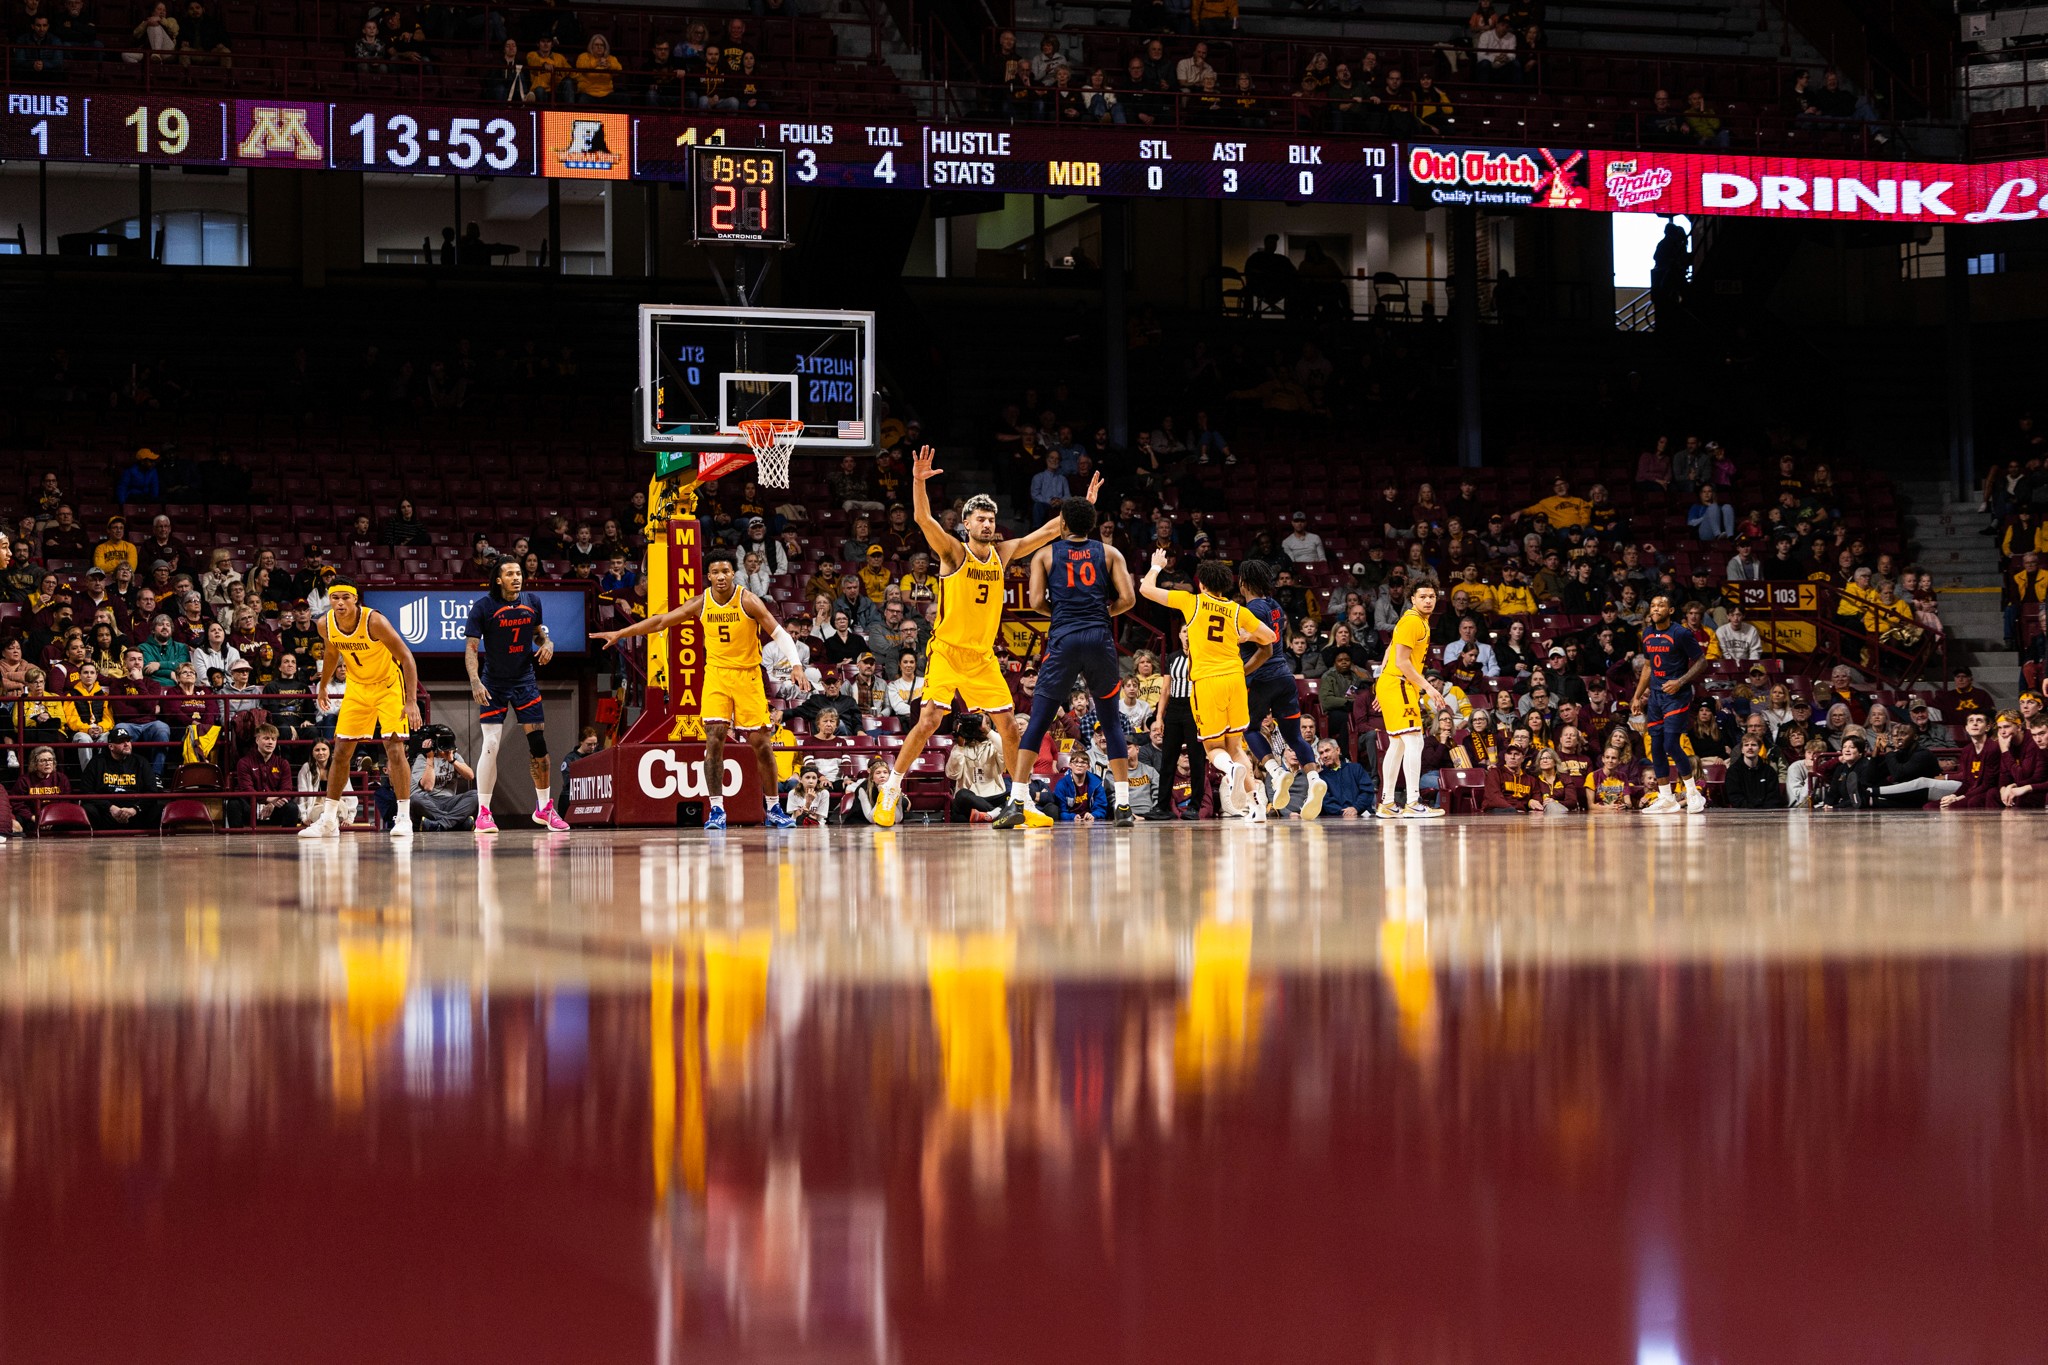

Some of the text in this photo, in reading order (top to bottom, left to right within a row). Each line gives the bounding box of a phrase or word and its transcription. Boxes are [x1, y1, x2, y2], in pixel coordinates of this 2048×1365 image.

[9, 94, 68, 116] FOULS
[30, 119, 48, 155] 1
[125, 106, 190, 154] 19
[779, 123, 834, 145] FOULS
[350, 113, 519, 171] 13:53
[931, 130, 1011, 156] HUSTLE
[1139, 139, 1173, 160] STL
[1212, 142, 1247, 162] AST
[796, 148, 818, 183] 3
[1288, 144, 1322, 165] BLK
[1362, 147, 1386, 167] TO
[873, 150, 897, 184] 4
[933, 160, 995, 185] STATS
[1049, 160, 1100, 187] MOR
[1147, 165, 1163, 191] 0
[1411, 149, 1537, 185] Old Dutch
[1222, 168, 1238, 193] 3
[1298, 170, 1314, 195] 0
[1372, 173, 1383, 198] 1
[1606, 168, 1671, 196] Prairie
[1432, 188, 1532, 205] Quality Lives Here
[1617, 187, 1661, 206] Farms
[1701, 172, 1957, 216] DRINK
[711, 185, 767, 230] 21
[1067, 549, 1091, 561] THOMAS
[966, 567, 1000, 582] MINNESOTA
[1066, 561, 1097, 588] 10
[975, 583, 989, 605] 3
[1773, 588, 1797, 604] 103
[707, 613, 741, 624] MINNESOTA
[1201, 600, 1233, 619] MITCHELL
[499, 617, 532, 628] MORGAN
[1207, 614, 1226, 643] 2
[1764, 629, 1802, 638] HALTH
[511, 627, 521, 643] 7
[718, 625, 731, 643] 5
[332, 640, 371, 651] MINNESOTA
[350, 652, 363, 667] 1
[1653, 654, 1662, 668] 0
[103, 772, 137, 786] GOPHERS
[569, 774, 613, 801] AFFINITY PLUS
